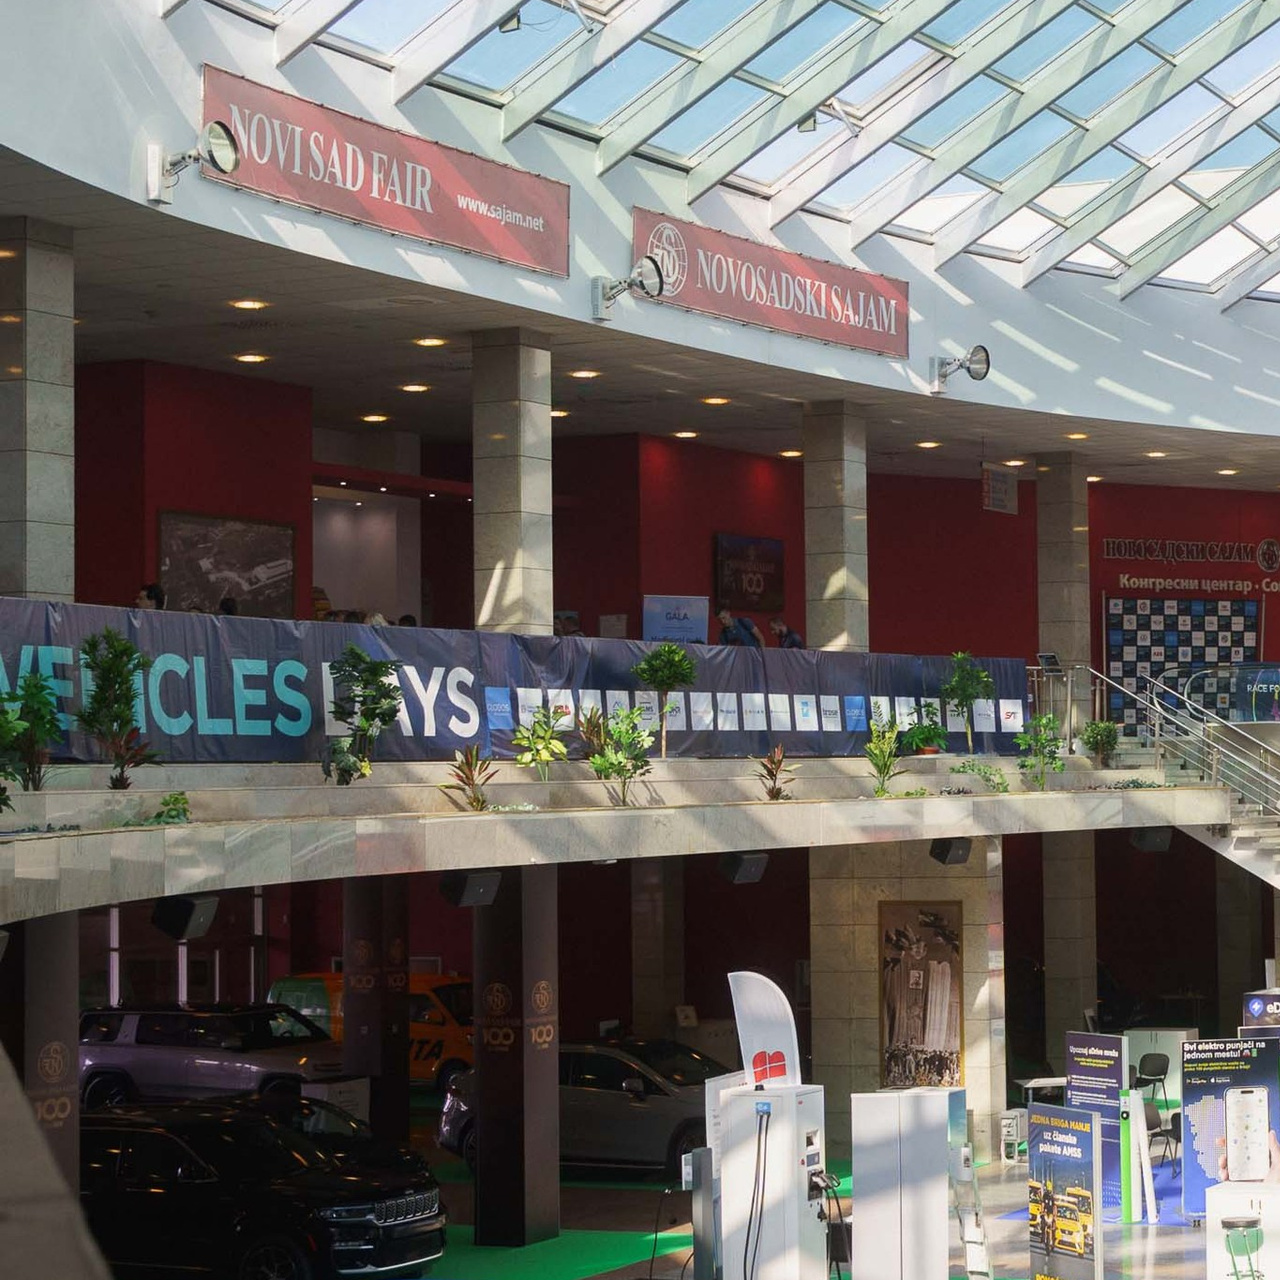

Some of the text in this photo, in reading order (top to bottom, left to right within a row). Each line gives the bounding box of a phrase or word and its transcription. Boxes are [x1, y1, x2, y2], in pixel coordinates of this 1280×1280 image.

[229, 103, 433, 213] NOVI SAD FAIR
[457, 193, 544, 232] www.sajam.net
[696, 248, 897, 335] NOVOSADSKI SAJAM
[1119, 573, 1251, 595] Конгресни центар
[665, 611, 690, 621] GALA
[483, 1026, 514, 1045] 100
[531, 1024, 554, 1044] 100
[1184, 1042, 1196, 1051] Svi
[1198, 1041, 1225, 1050] elektro
[1256, 1041, 1266, 1049] na
[1183, 1051, 1212, 1061] jednom
[1043, 1131, 1052, 1140] uz
